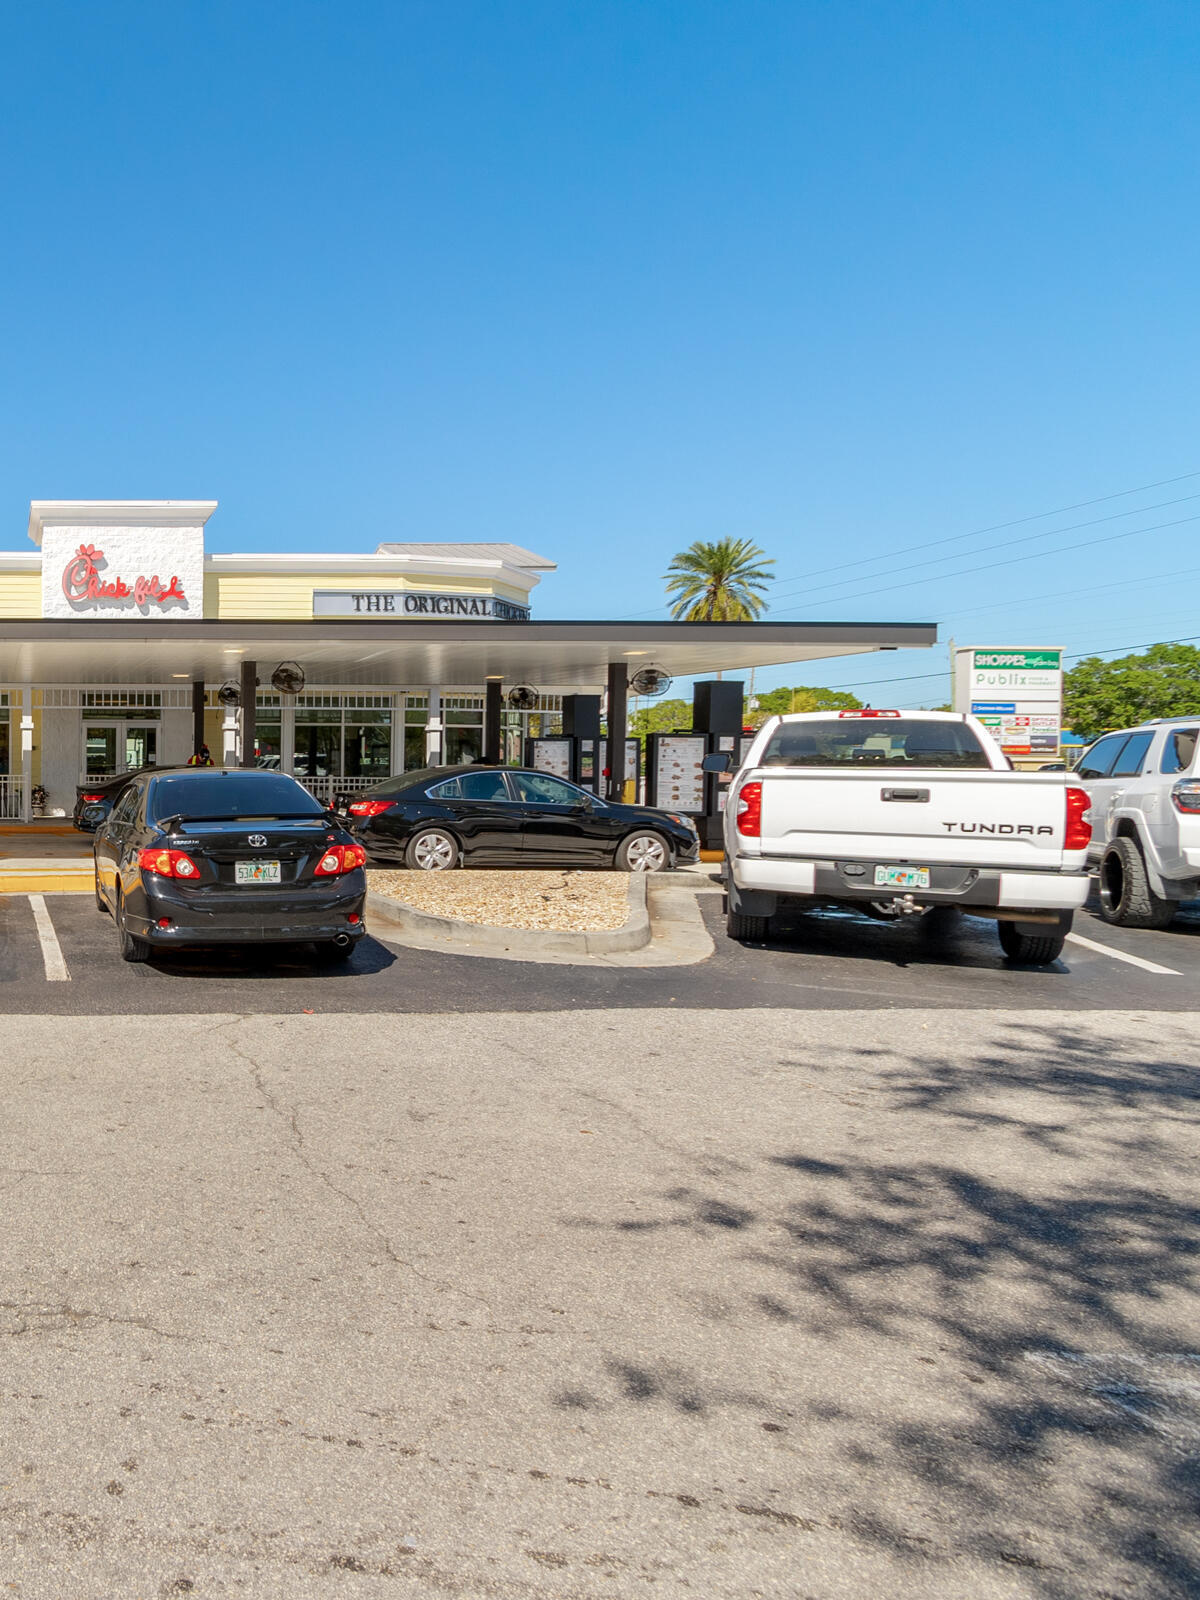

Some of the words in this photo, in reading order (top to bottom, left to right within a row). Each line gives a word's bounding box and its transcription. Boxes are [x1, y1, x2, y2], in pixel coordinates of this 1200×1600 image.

[62, 544, 184, 605] Chick-fil-A
[352, 594, 394, 612] THE
[404, 595, 491, 616] ORIGINAL
[975, 655, 1026, 666] SHOPPES
[976, 673, 1026, 685] Publix
[942, 822, 1054, 835] TUNDRA
